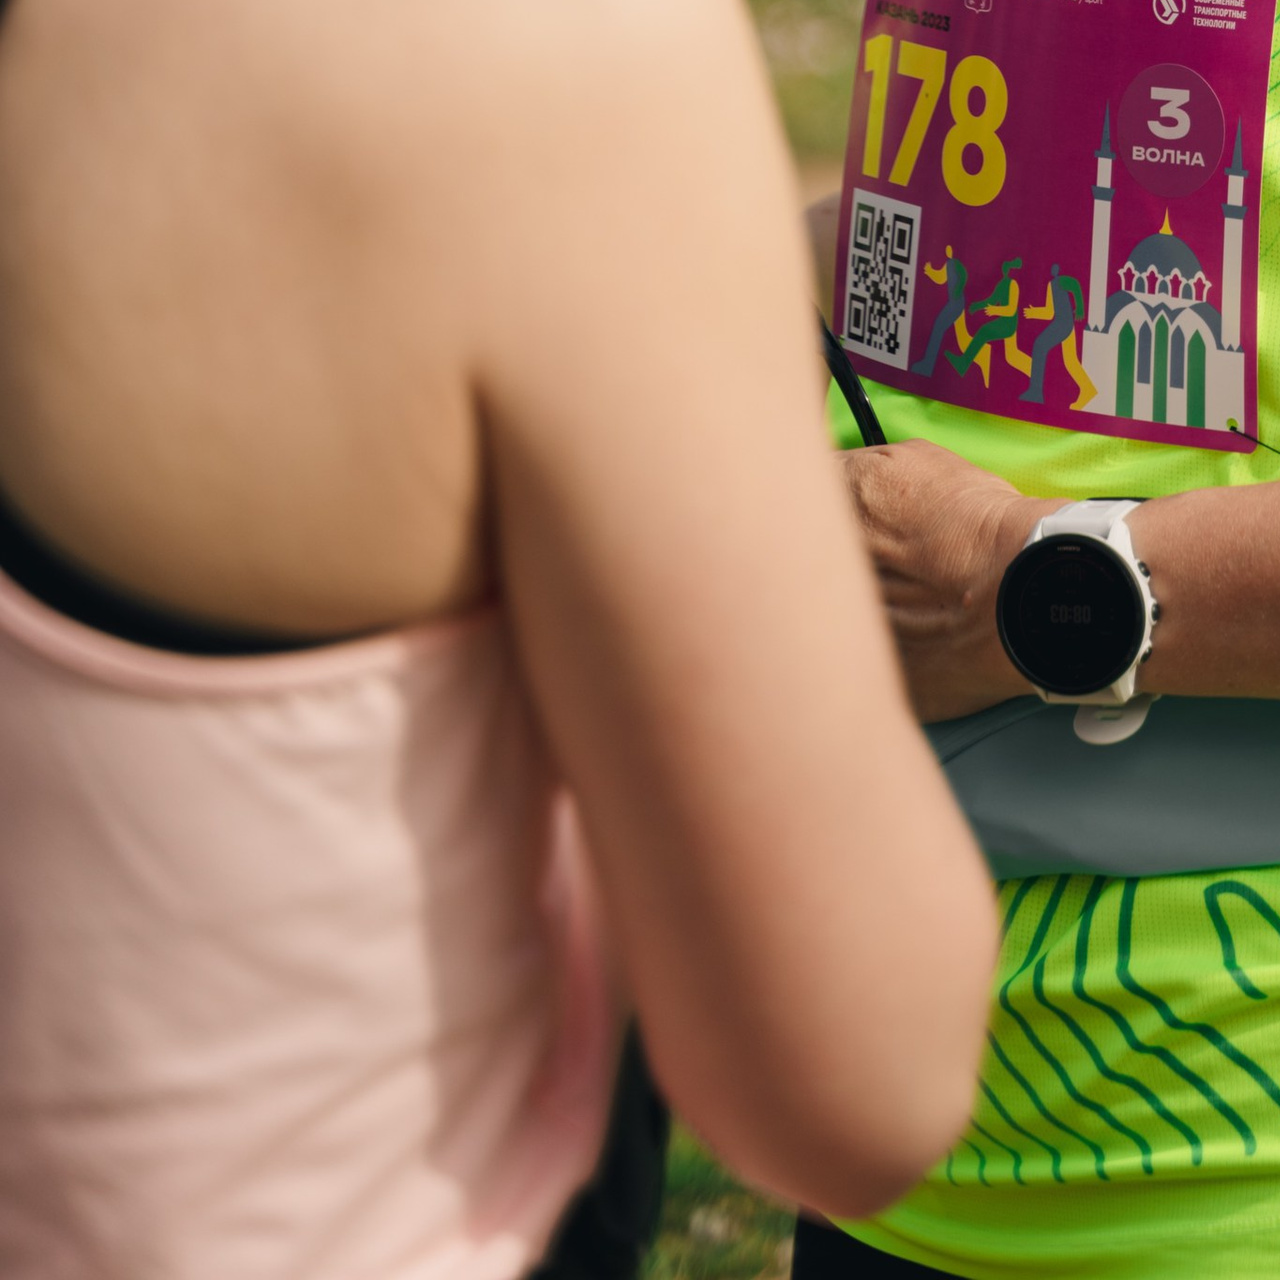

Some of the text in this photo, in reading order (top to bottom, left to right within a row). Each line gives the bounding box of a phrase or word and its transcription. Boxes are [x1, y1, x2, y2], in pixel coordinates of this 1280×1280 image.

[920, 10, 951, 32] 2023
[1192, 17, 1237, 30] ТЕХНОЛОГИИ
[1193, 5, 1248, 20] ТРАНСПОРТНЫЕ
[862, 33, 1009, 207] 178
[1146, 86, 1191, 140] 3
[1132, 145, 1206, 167] ВОЛНА
